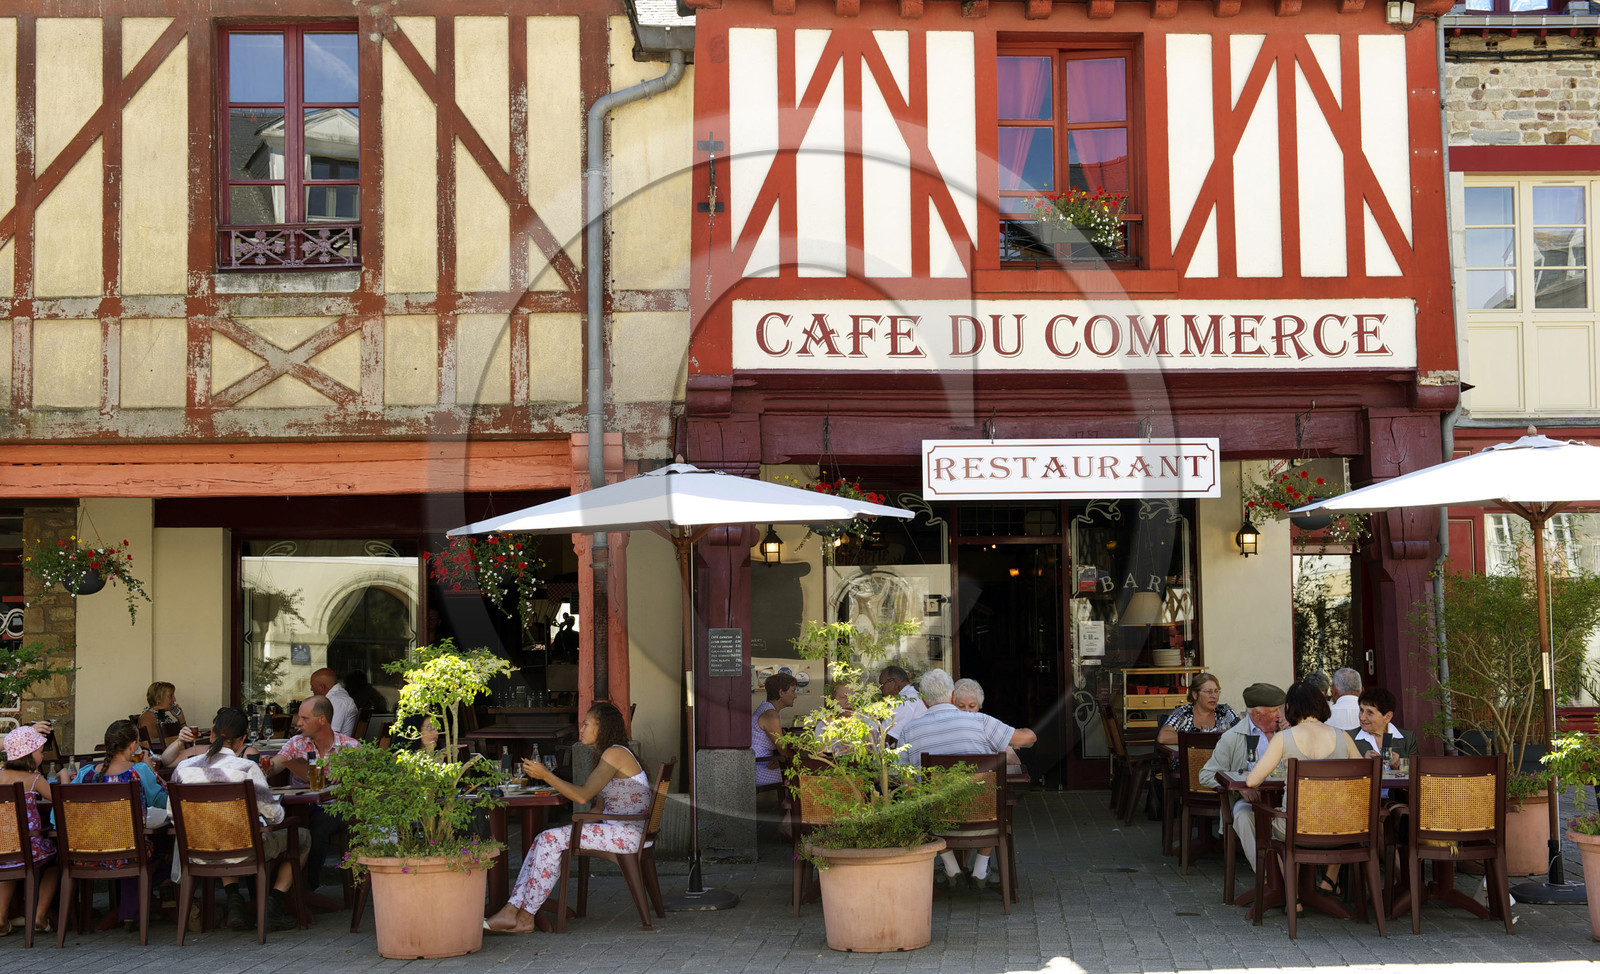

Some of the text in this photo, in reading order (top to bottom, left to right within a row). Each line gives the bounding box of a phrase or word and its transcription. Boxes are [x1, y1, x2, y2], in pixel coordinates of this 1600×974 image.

[756, 312, 1393, 361] CAFE DU COMMERCE
[934, 455, 1208, 482] RESTAURANT
[1099, 572, 1162, 593] BAR
